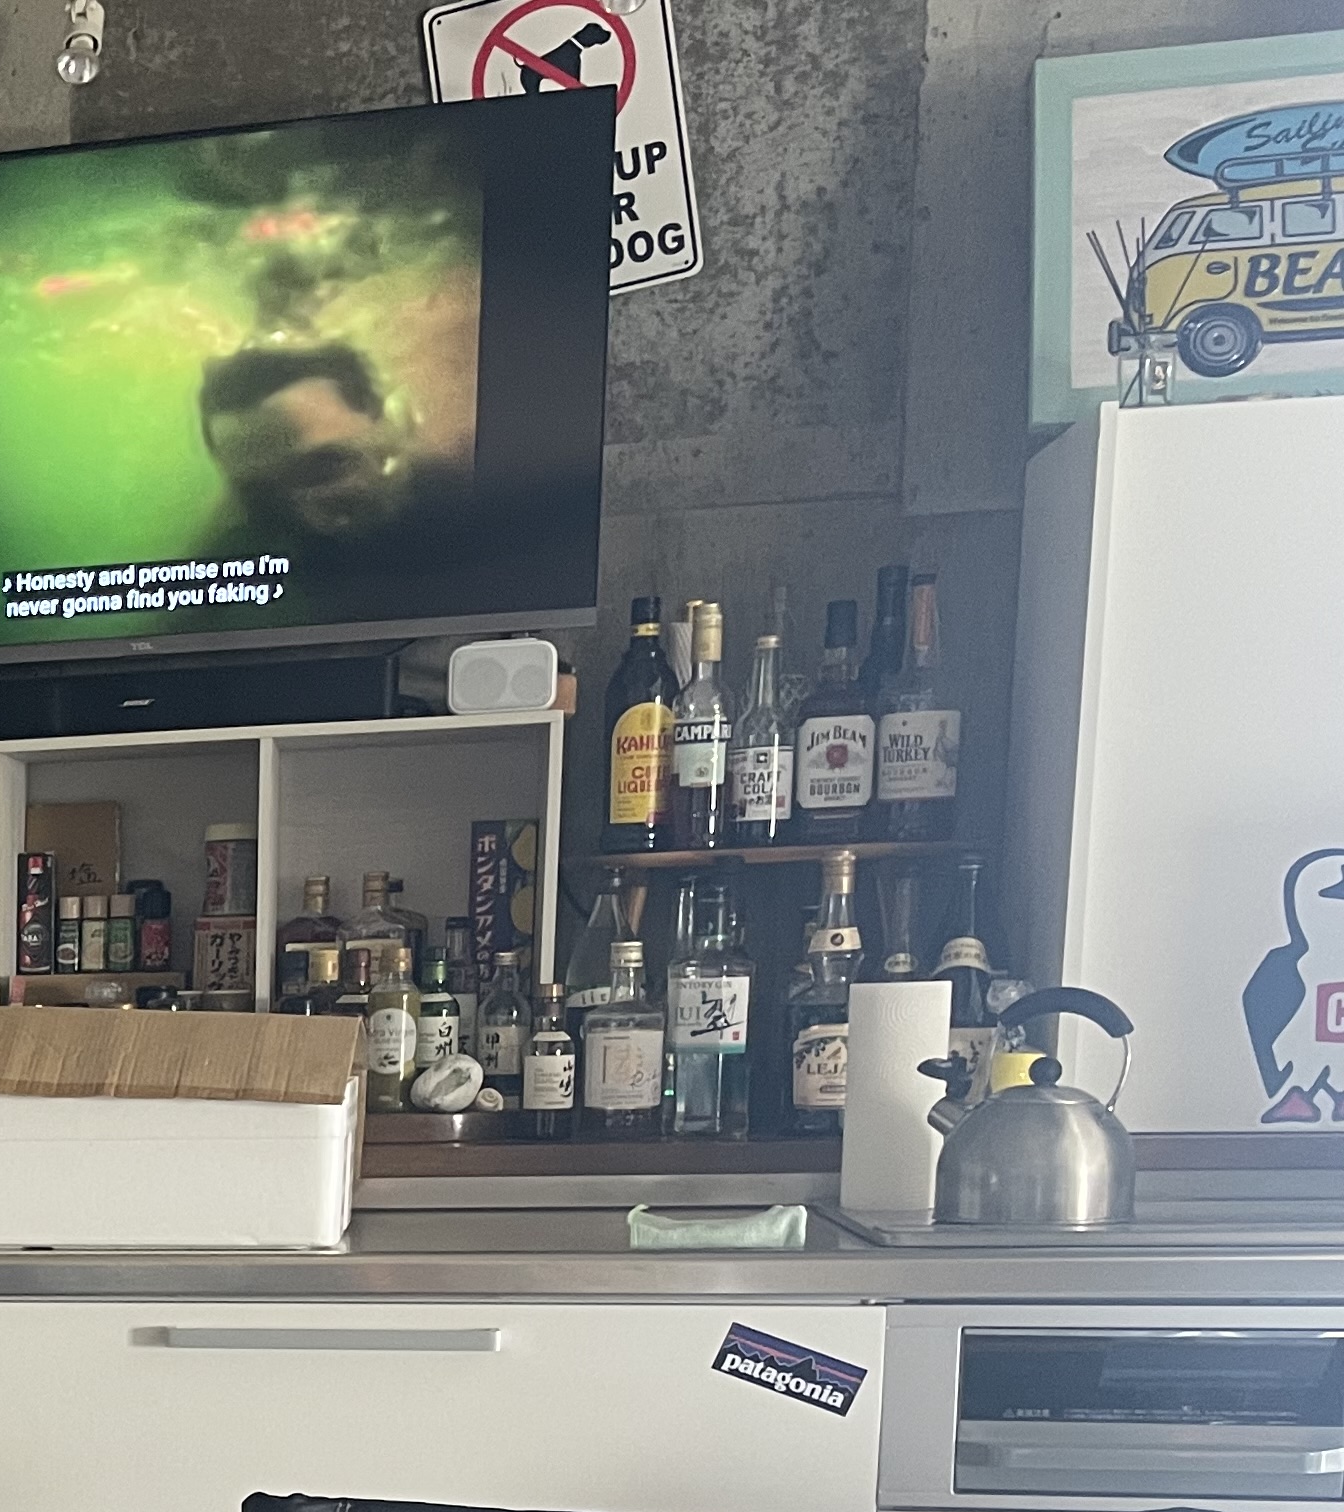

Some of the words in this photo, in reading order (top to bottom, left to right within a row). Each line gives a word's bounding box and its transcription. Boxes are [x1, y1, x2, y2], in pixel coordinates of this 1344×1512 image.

[614, 141, 667, 181] UP
[16, 570, 95, 593] Honesty
[98, 565, 135, 585] and
[138, 561, 218, 588] promise
[222, 558, 254, 577] me
[258, 554, 289, 575] I'm
[6, 599, 59, 618] never
[62, 593, 122, 618] gonna
[126, 588, 164, 608] find
[168, 588, 203, 610] you
[208, 582, 269, 604] faking
[674, 723, 732, 742] CAMPARI
[806, 730, 831, 751] JIM
[833, 725, 867, 748] BEAM
[889, 733, 923, 748] WILD
[882, 747, 931, 763] TURKEY
[740, 771, 782, 783] CRAFT
[809, 783, 861, 796] BOURBON
[720, 1352, 845, 1408] patagonia
